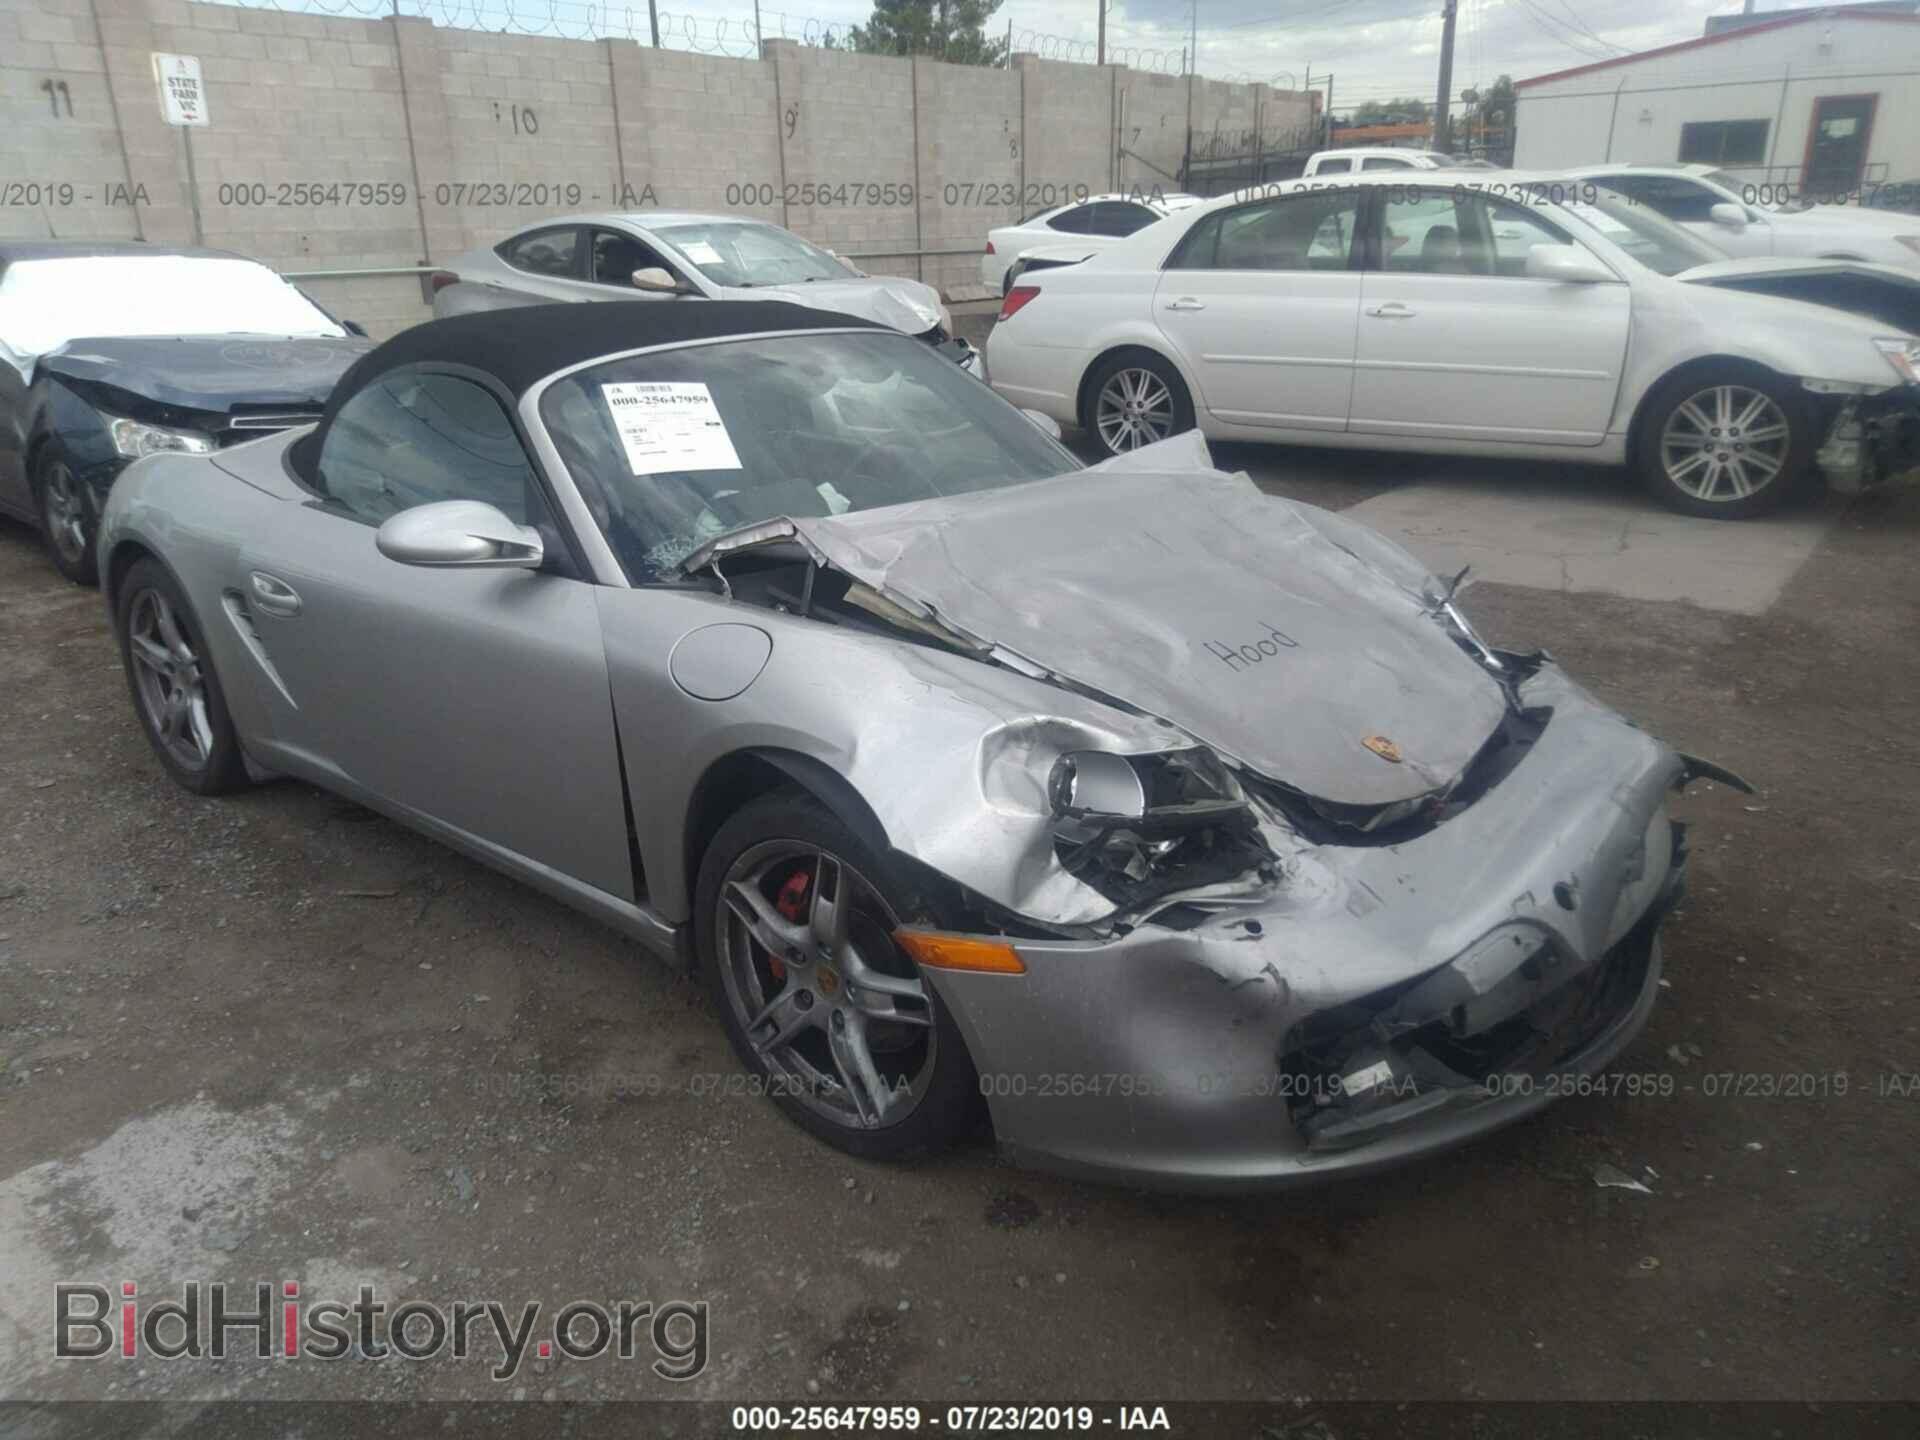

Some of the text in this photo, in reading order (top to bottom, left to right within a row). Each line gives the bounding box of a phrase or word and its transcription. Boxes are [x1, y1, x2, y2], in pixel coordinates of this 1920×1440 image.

[168, 77, 198, 89] STATE
[511, 104, 539, 136] 10
[784, 108, 797, 139] 9
[1204, 622, 1299, 672] Hood
